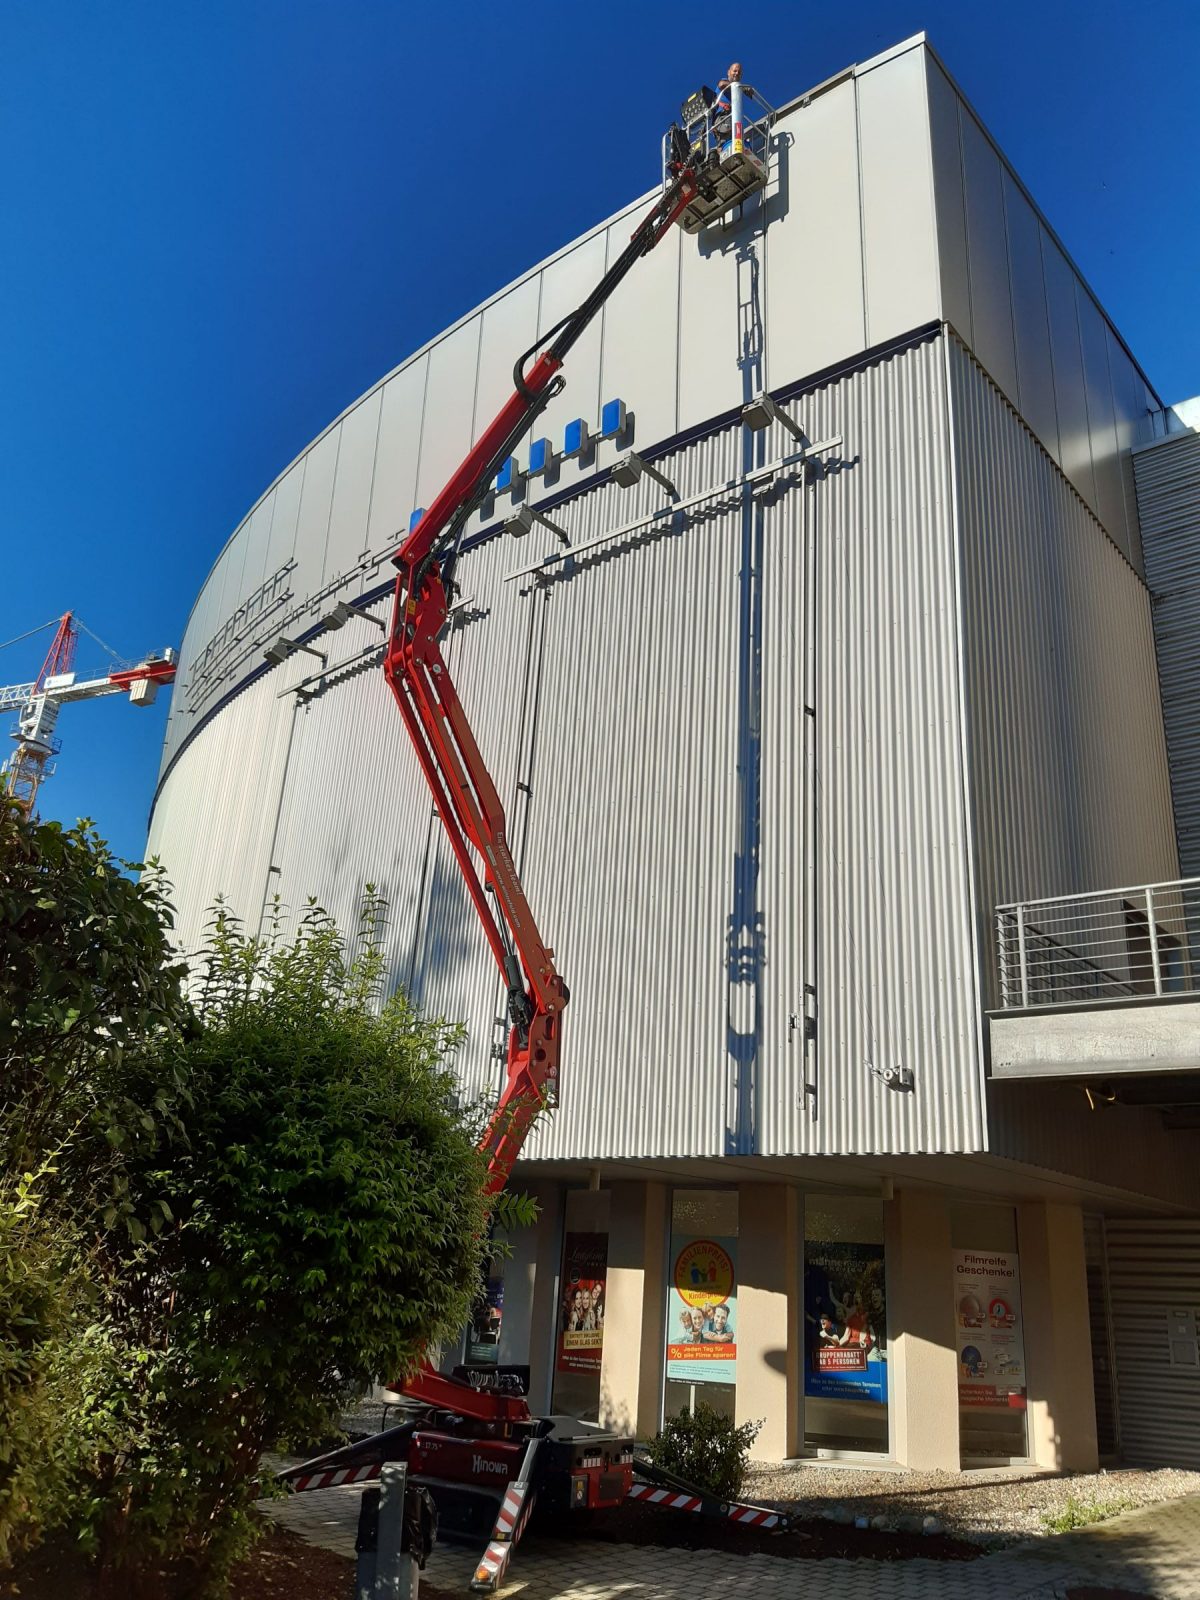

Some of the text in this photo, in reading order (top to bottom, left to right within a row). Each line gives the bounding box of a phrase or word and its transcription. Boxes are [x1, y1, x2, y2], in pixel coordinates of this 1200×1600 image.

[509, 871, 523, 896] Team!
[964, 1255, 1006, 1266] Filmreife
[956, 1265, 1015, 1278] Geschenke!
[472, 1453, 508, 1476] Hinowa
